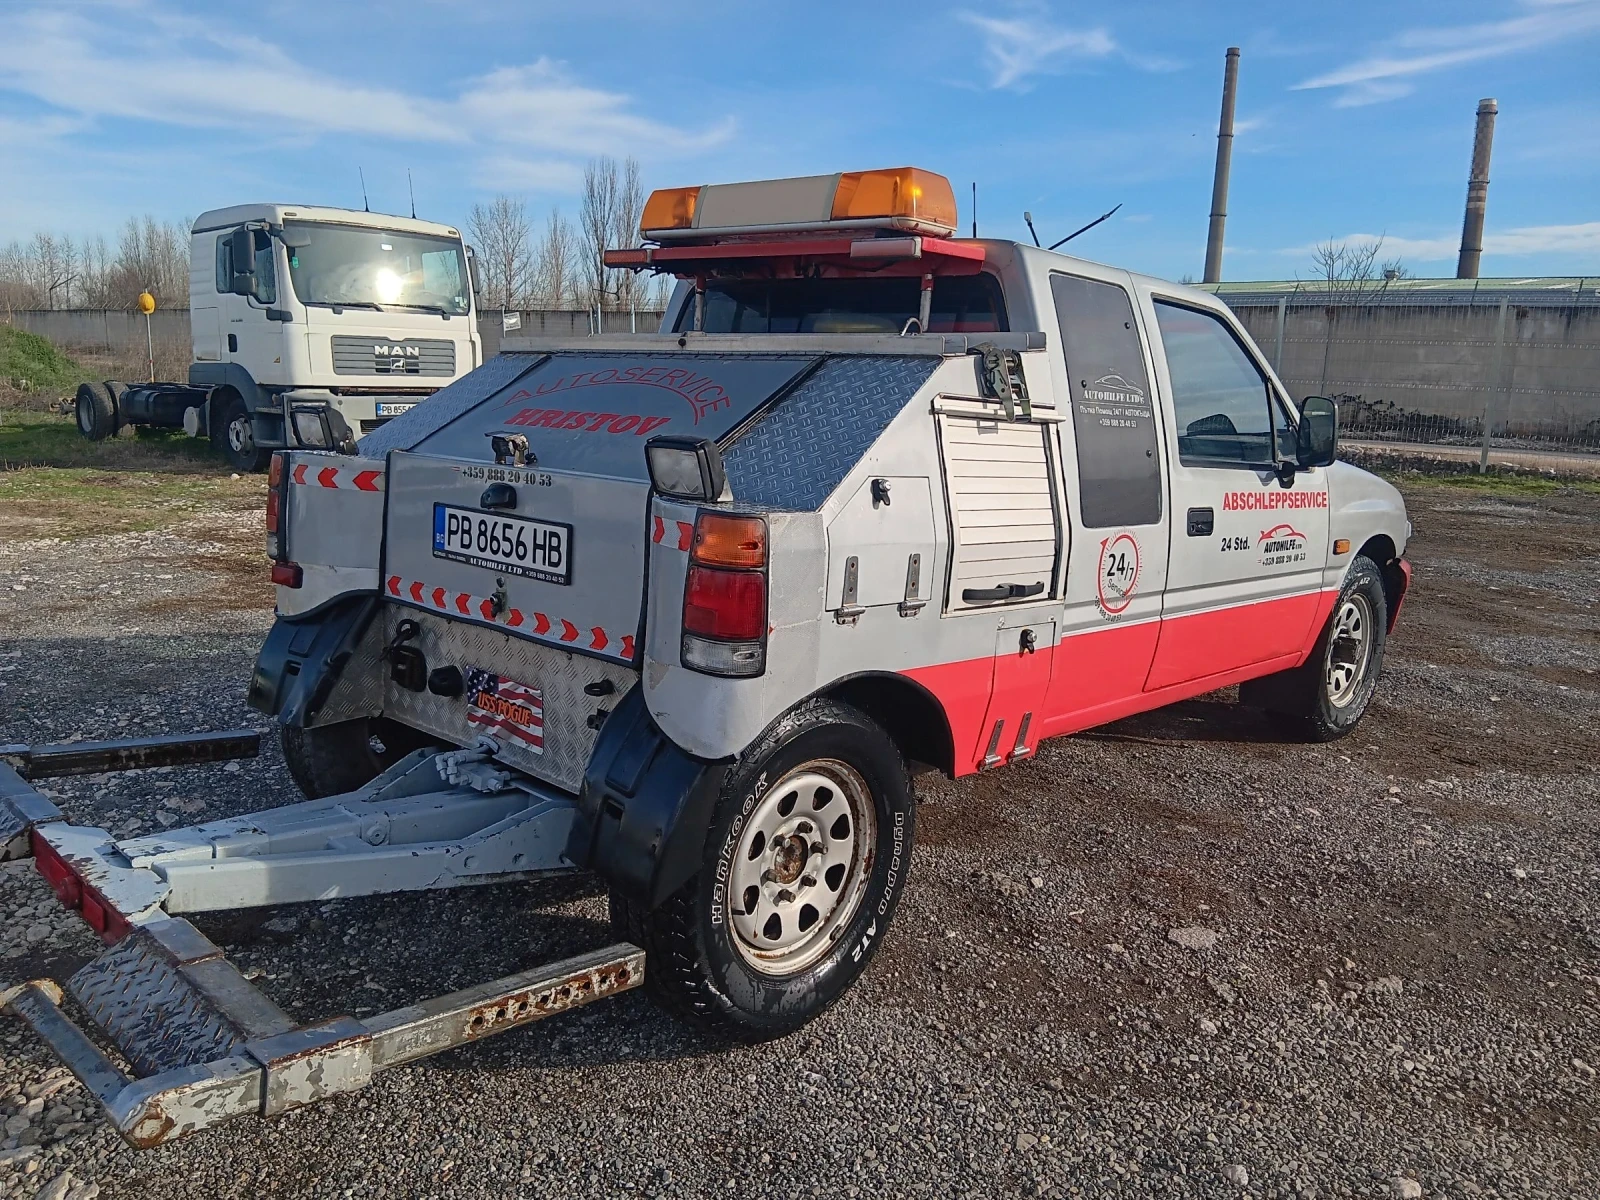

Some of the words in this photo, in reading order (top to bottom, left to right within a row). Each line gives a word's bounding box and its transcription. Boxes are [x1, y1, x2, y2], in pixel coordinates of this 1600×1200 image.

[374, 345, 420, 357] MAN
[505, 367, 730, 417] AUTOSERVICE
[1083, 390, 1125, 401] AUTOHILFE
[1126, 393, 1140, 403] LTD
[381, 405, 393, 414] PB
[504, 408, 671, 436] HRISTOV
[507, 470, 520, 484] 20
[523, 472, 536, 486] 40
[539, 474, 552, 487] 53
[1222, 491, 1328, 511] ABSCHLEPPSERVICE
[447, 513, 473, 550] PB
[476, 519, 528, 561] 8656
[532, 527, 563, 568] HB
[1220, 537, 1232, 552] 24
[1233, 536, 1250, 551] Std.
[1263, 539, 1296, 554] AUTOHILFE
[469, 557, 507, 573] AUTOHILFE
[508, 565, 523, 575] LTD
[1106, 552, 1135, 582] 24/7
[477, 691, 496, 713] USS
[497, 700, 532, 727] POGUE
[851, 916, 877, 963] AT2
